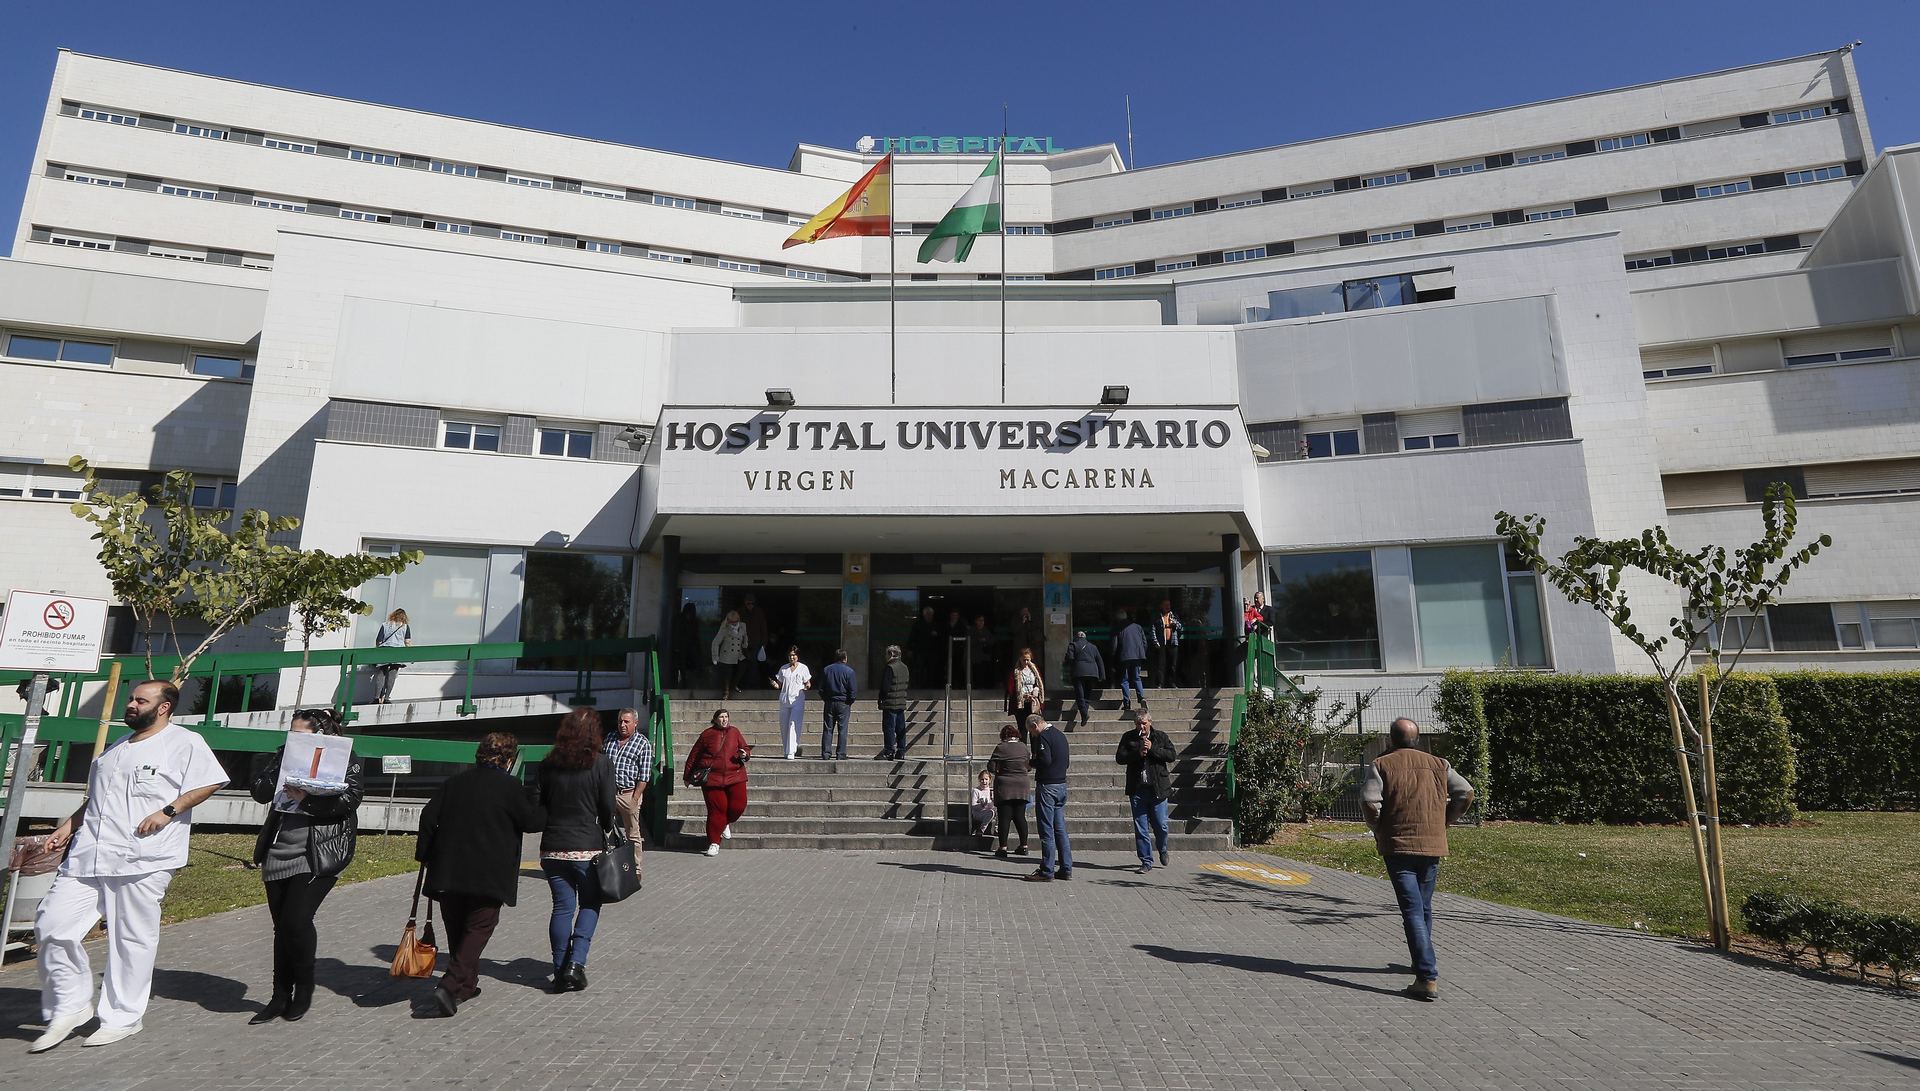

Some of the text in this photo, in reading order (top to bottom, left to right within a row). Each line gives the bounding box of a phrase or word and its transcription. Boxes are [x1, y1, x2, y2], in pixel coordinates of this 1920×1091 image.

[883, 135, 1064, 153] HOSPITAL
[665, 420, 1231, 451] HOSPITAL UNIVERSITARIO
[743, 468, 1155, 491] VIRGEN MACARENA
[22, 630, 86, 641] PROHIBIDO FUMAR
